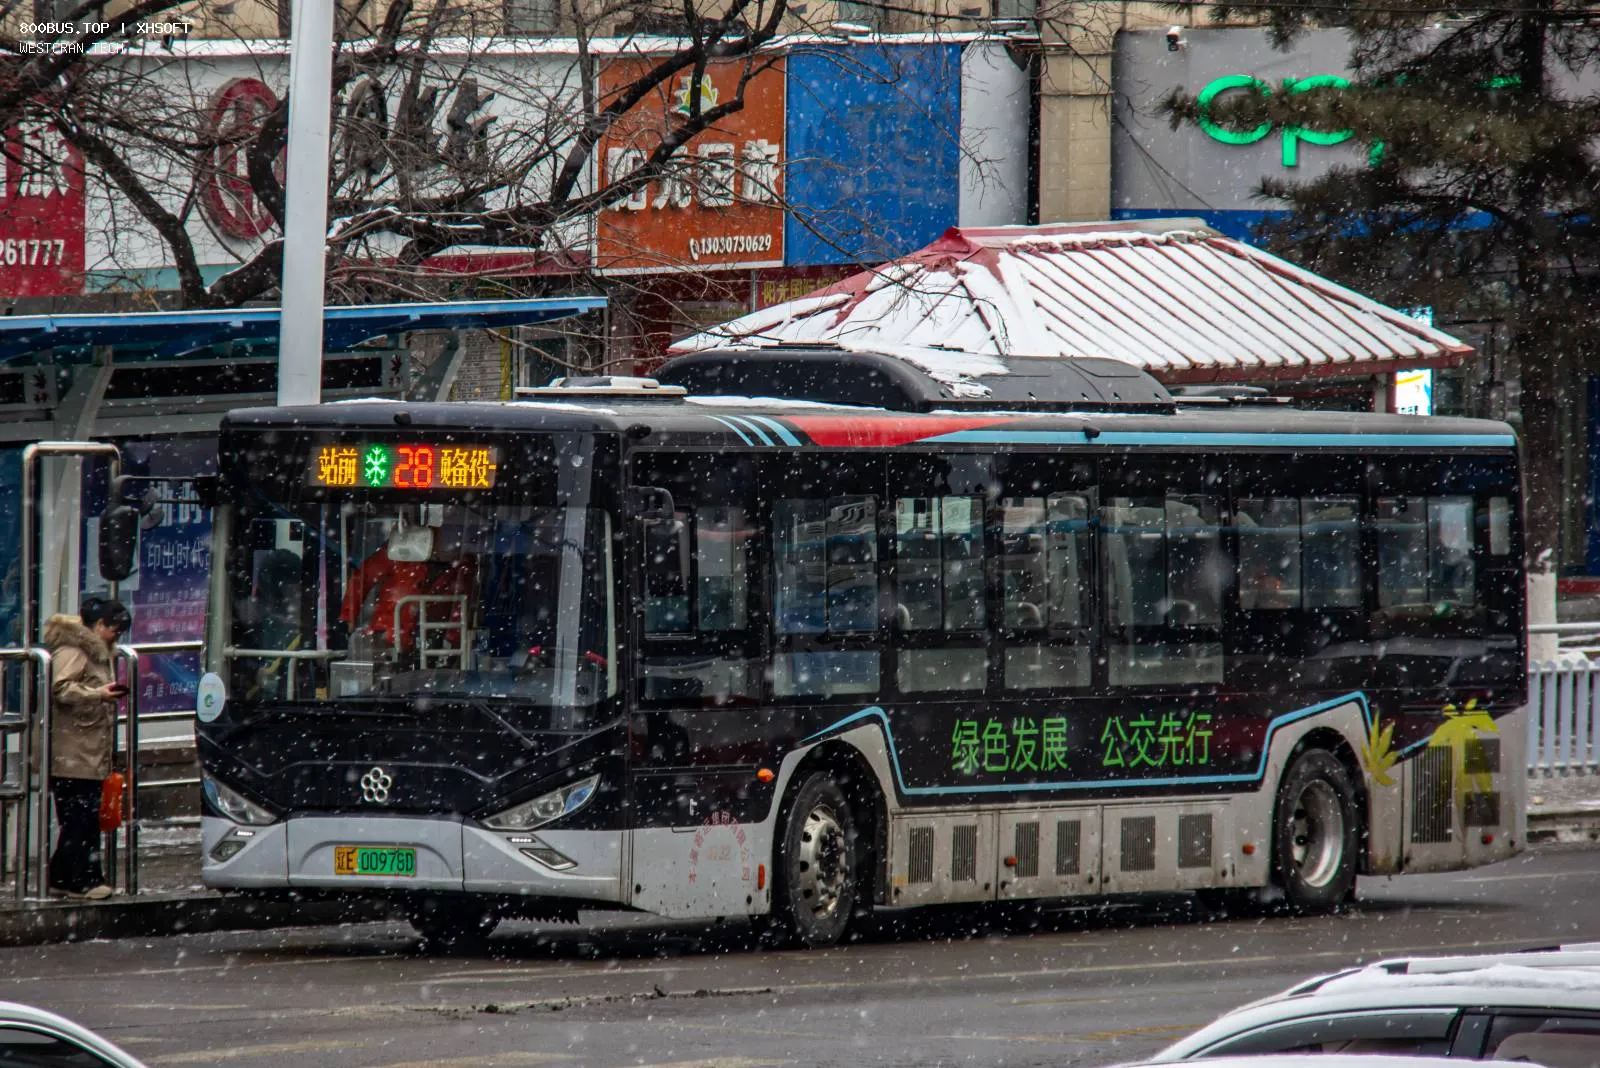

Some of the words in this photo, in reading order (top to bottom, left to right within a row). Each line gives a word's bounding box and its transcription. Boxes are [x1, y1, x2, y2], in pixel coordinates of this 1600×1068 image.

[318, 447, 358, 485] 站前
[394, 446, 433, 488] 28
[951, 717, 1069, 774] 绿色发展
[1100, 712, 1213, 768] 公交先行
